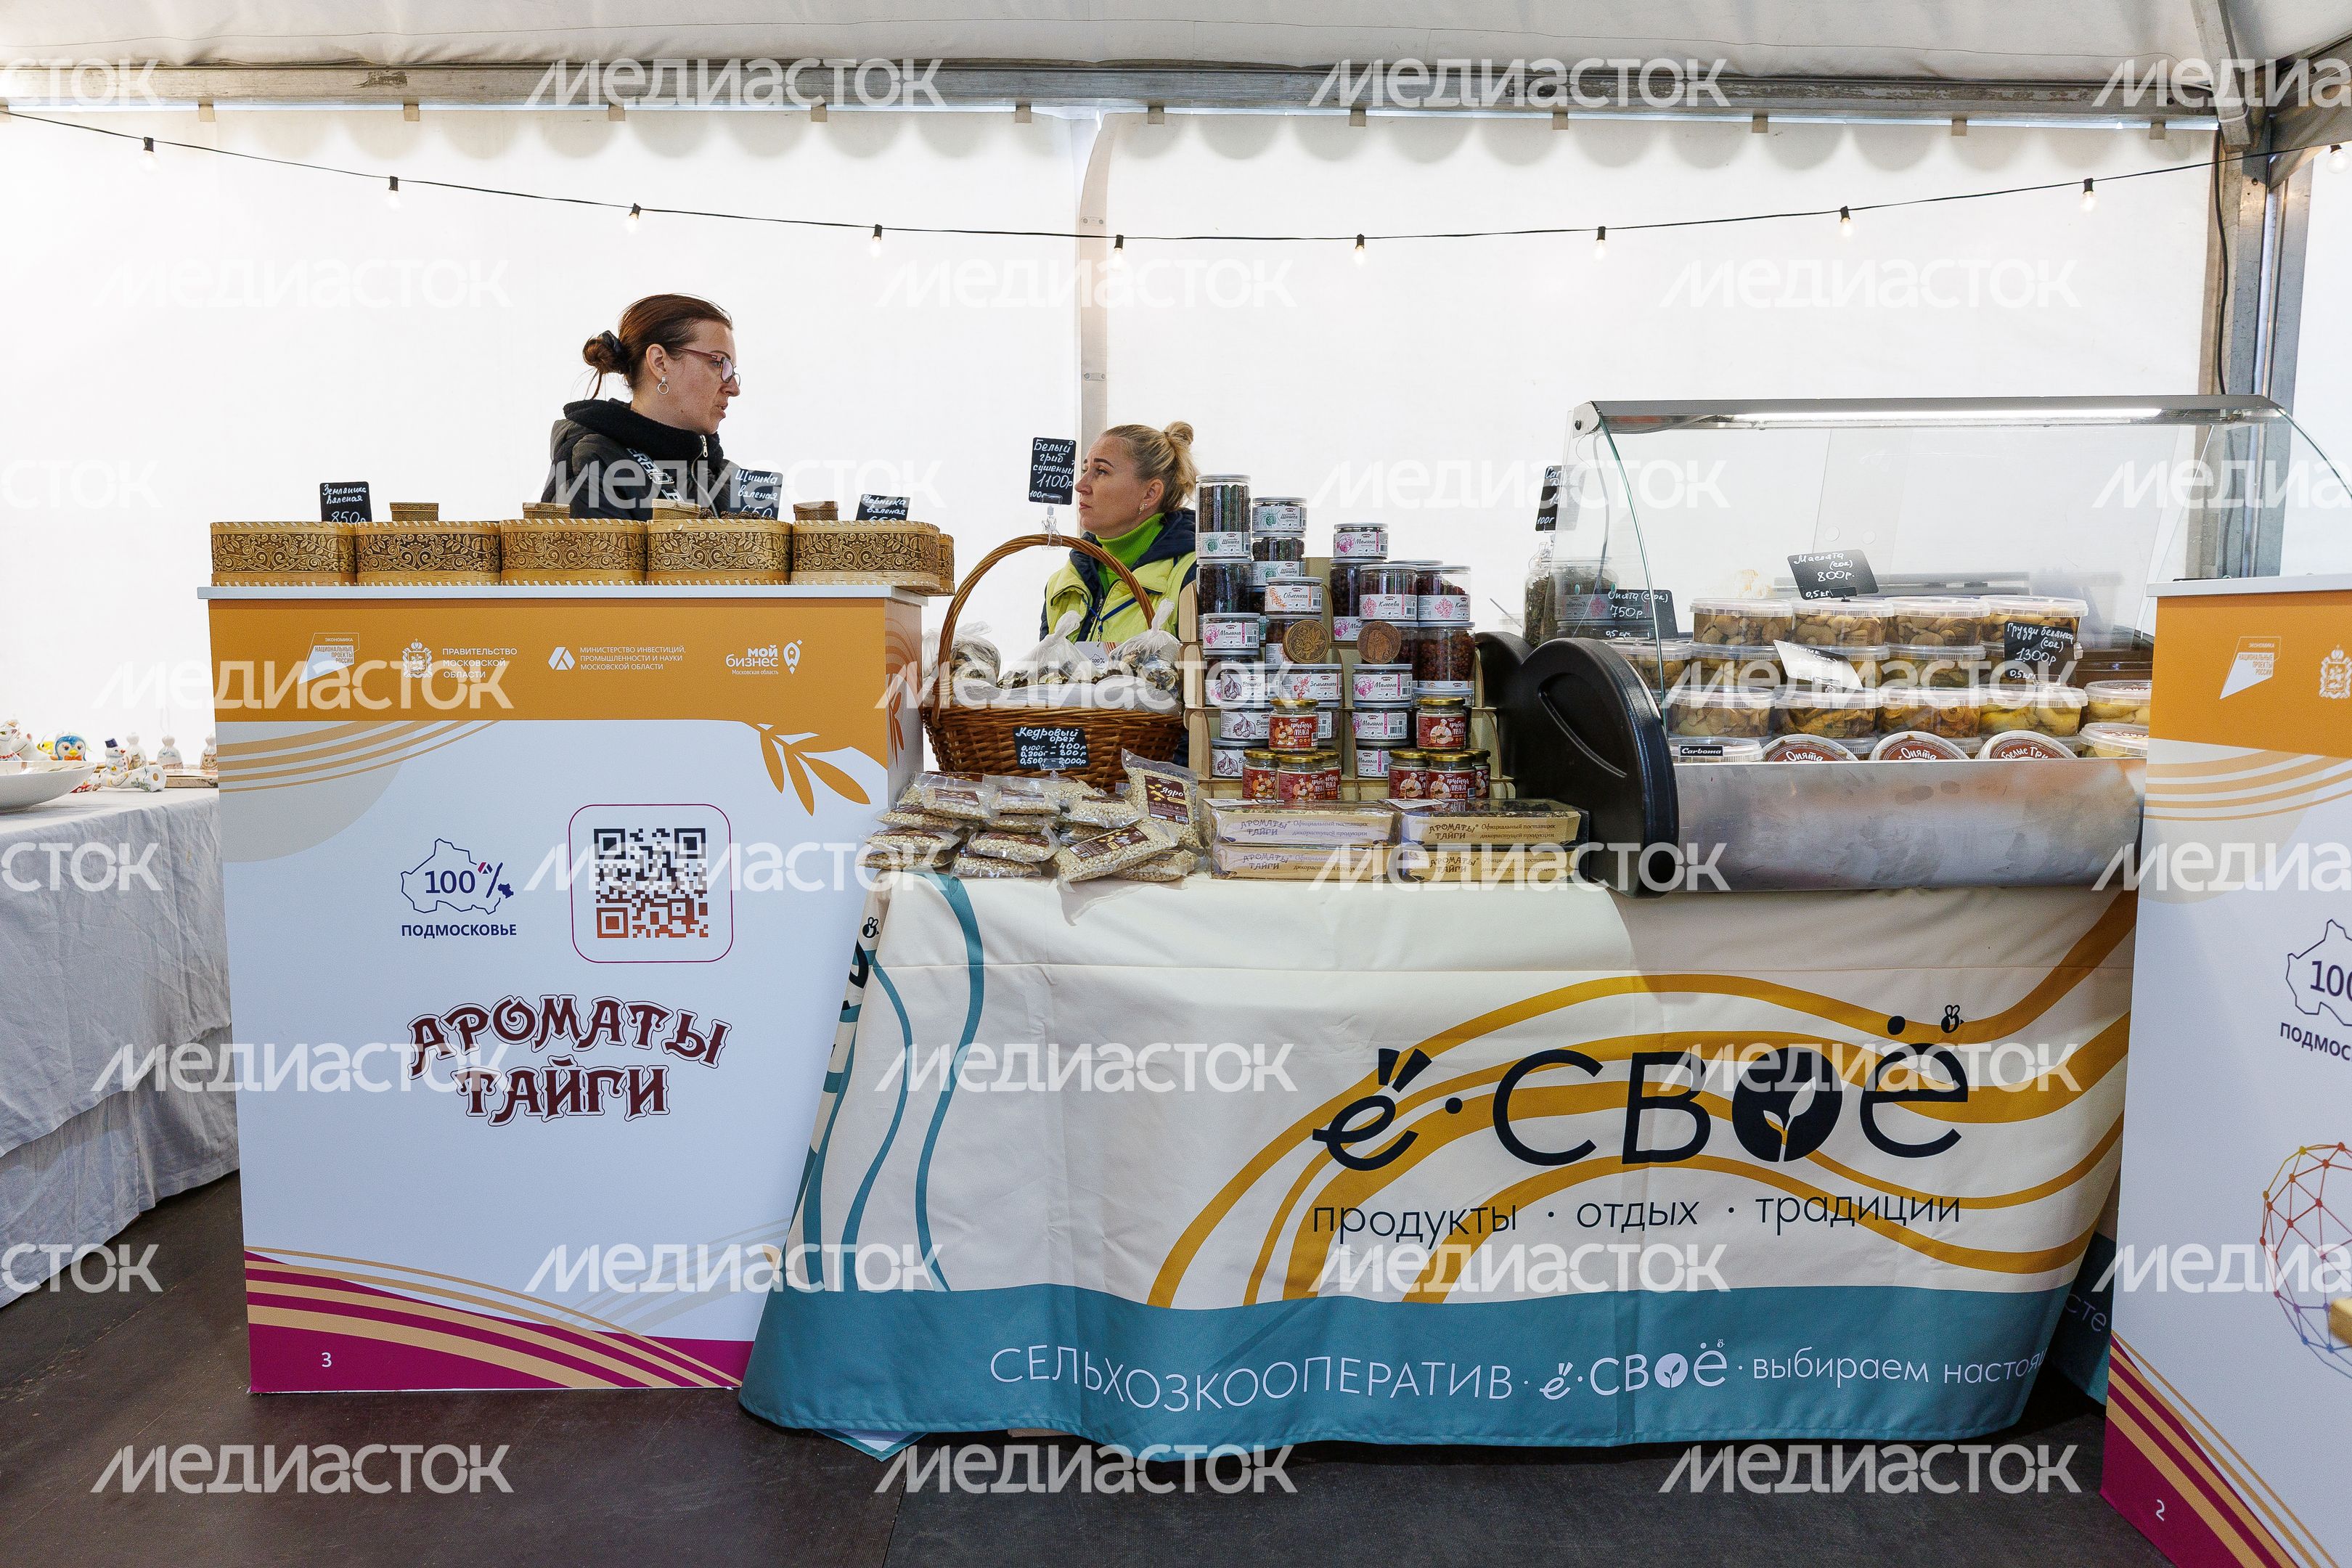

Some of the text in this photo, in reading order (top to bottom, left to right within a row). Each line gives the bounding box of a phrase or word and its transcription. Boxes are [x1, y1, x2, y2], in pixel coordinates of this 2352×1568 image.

[1034, 439, 1074, 453] Белый
[1040, 453, 1066, 465] гриб
[637, 645, 686, 654] ИНВЕСТИЦИЙ,
[747, 644, 778, 658] мой
[442, 657, 506, 667] МОСКОВСКОЙ
[579, 662, 629, 671] МОСКОВСКОЙ
[725, 653, 779, 667] бизнес
[1016, 727, 1079, 740] Кедровый
[1050, 735, 1075, 745] орех
[401, 923, 517, 939] ПОДМОСКОВЬЕ
[408, 995, 732, 1079] АРОМАТЫ
[451, 1055, 670, 1127] ТАЙГИ
[1312, 1191, 1961, 1244] продукты отдых традиции
[322, 1351, 332, 1368] 3
[989, 1343, 1513, 1412] СЕЛЬХОЗКООПЕРАТИВ
[1752, 1345, 1930, 1389] выбираем
[2155, 1498, 2165, 1522] 2
